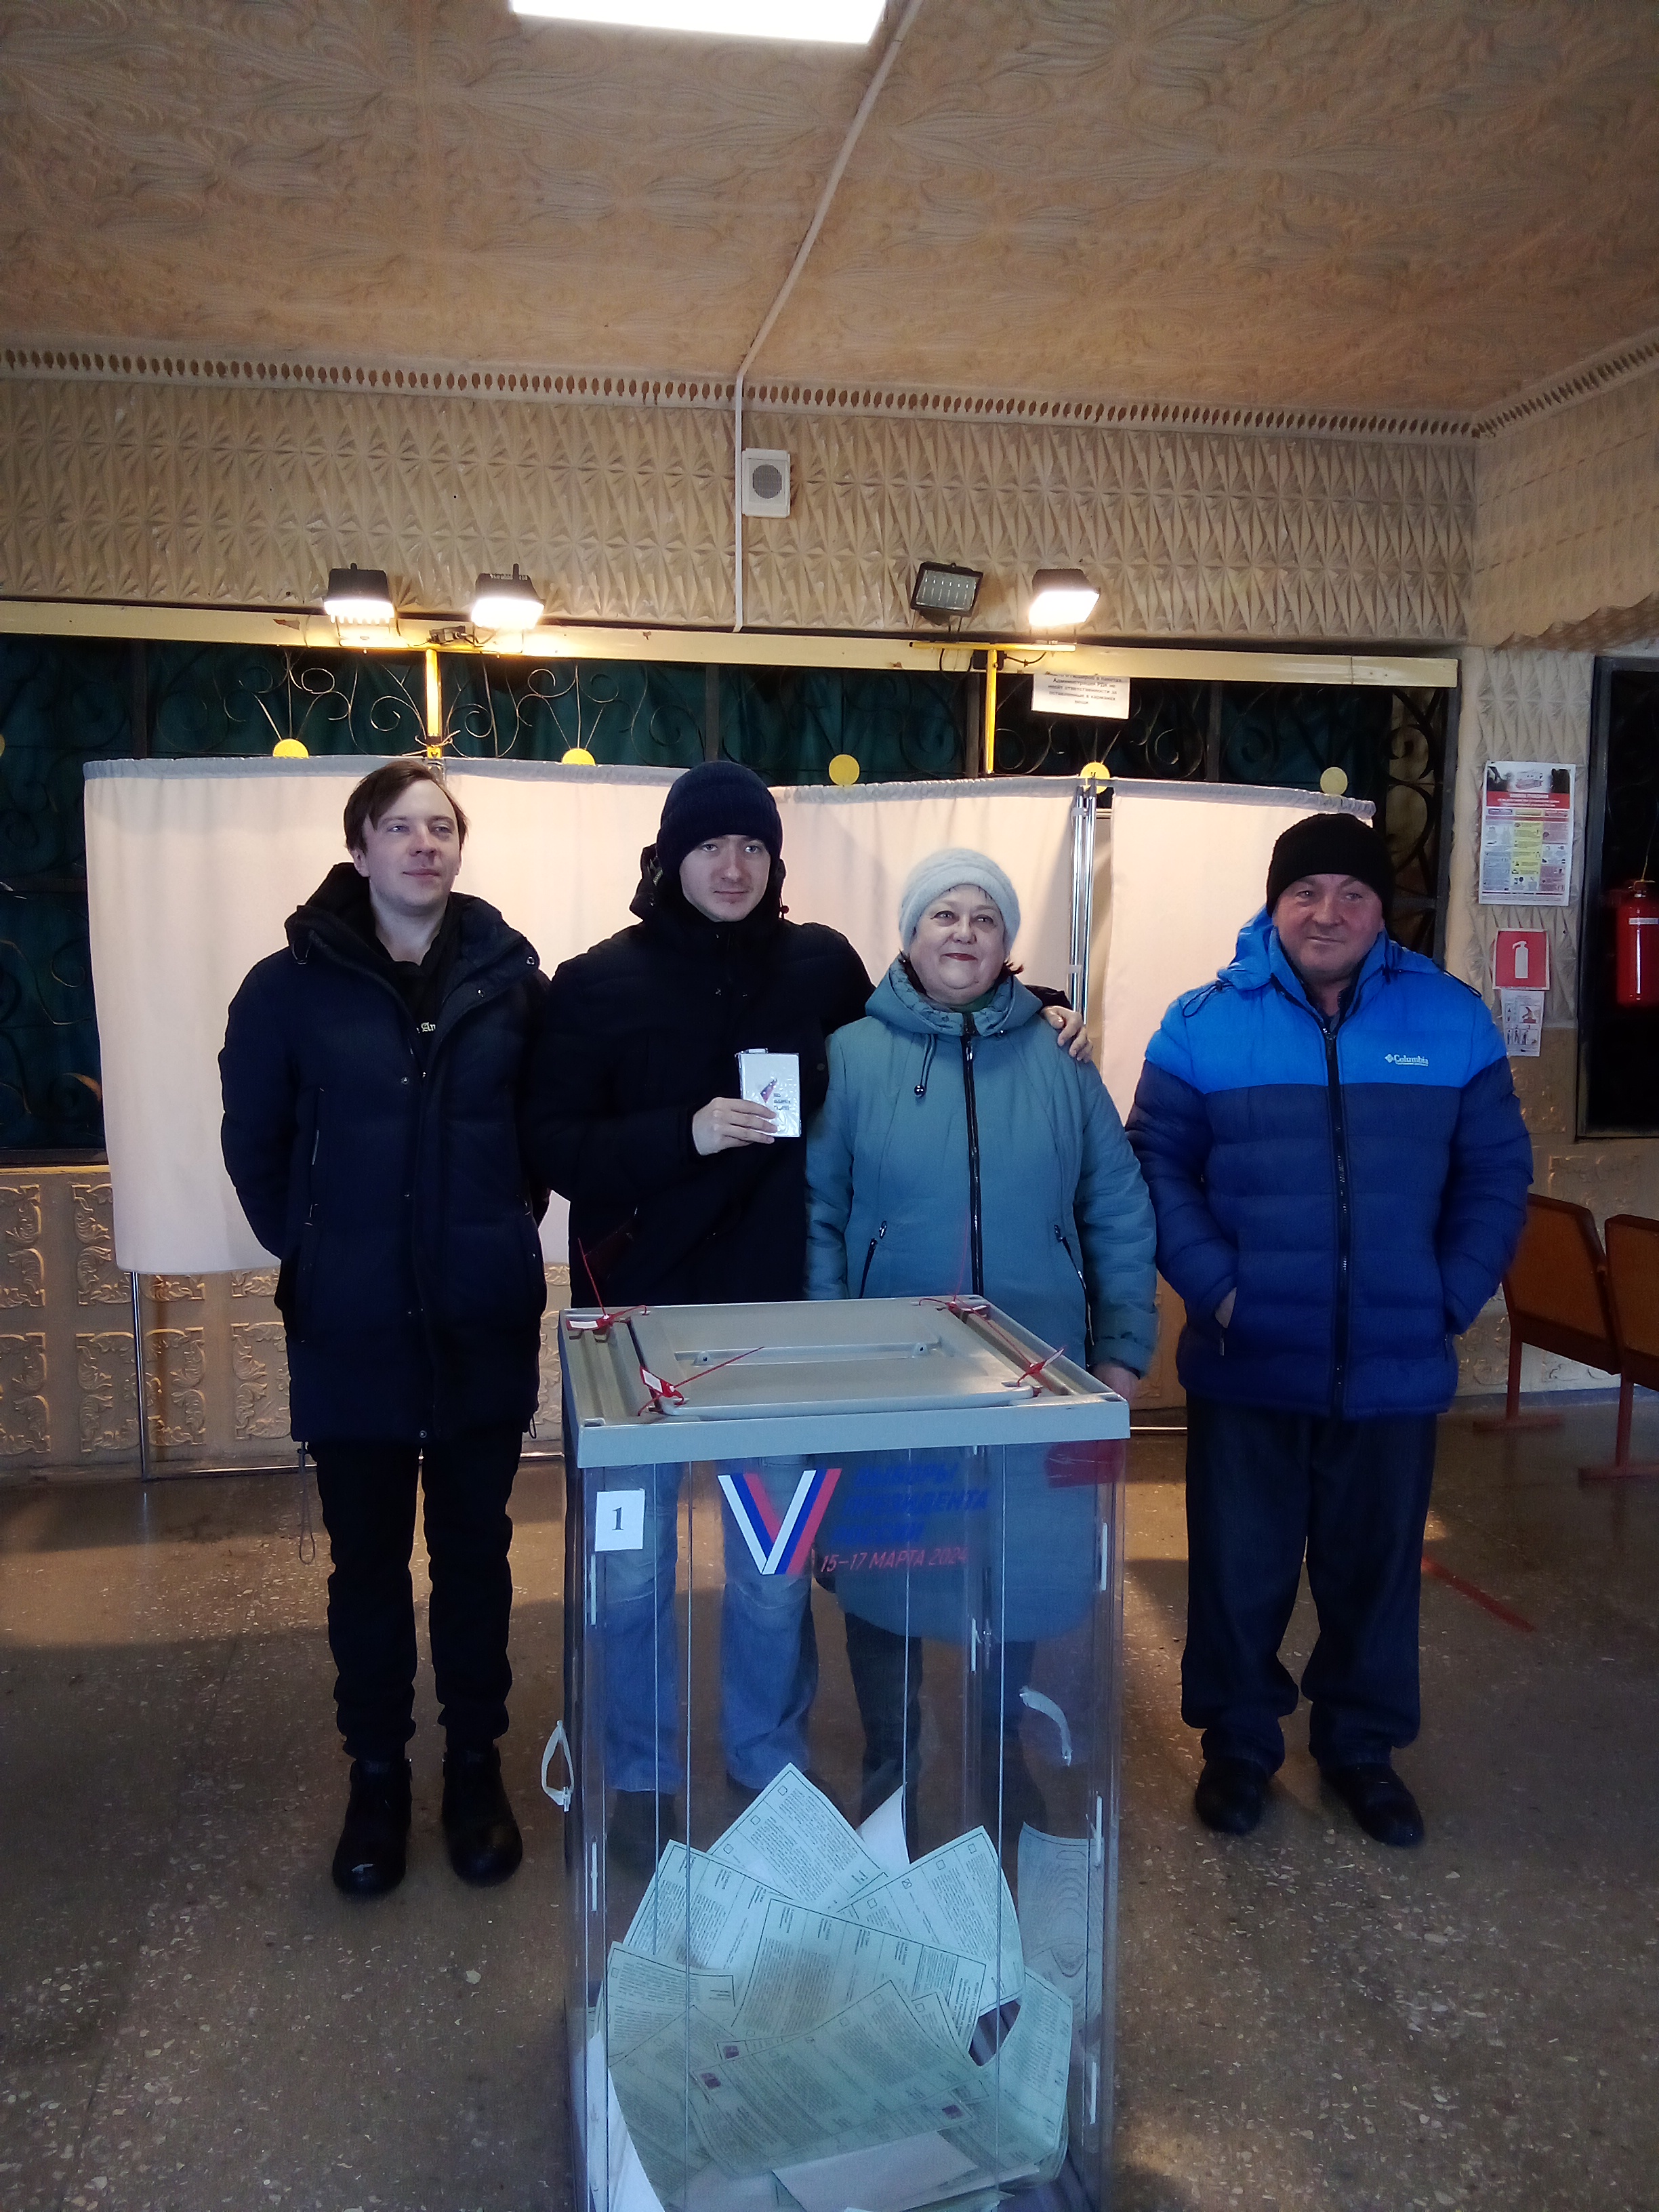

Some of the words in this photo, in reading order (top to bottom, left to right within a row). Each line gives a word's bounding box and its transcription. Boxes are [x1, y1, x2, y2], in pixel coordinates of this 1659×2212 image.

[1394, 1054, 1429, 1065] Columbia
[854, 1463, 958, 1487] ВЫБОРЫ
[844, 1490, 987, 1515] ПРЕЗИДЕНТА
[612, 1507, 624, 1531] 1
[832, 1521, 925, 1544] РОССИИ
[869, 1549, 926, 1570] МАРТА
[928, 1547, 968, 1567] 2024
